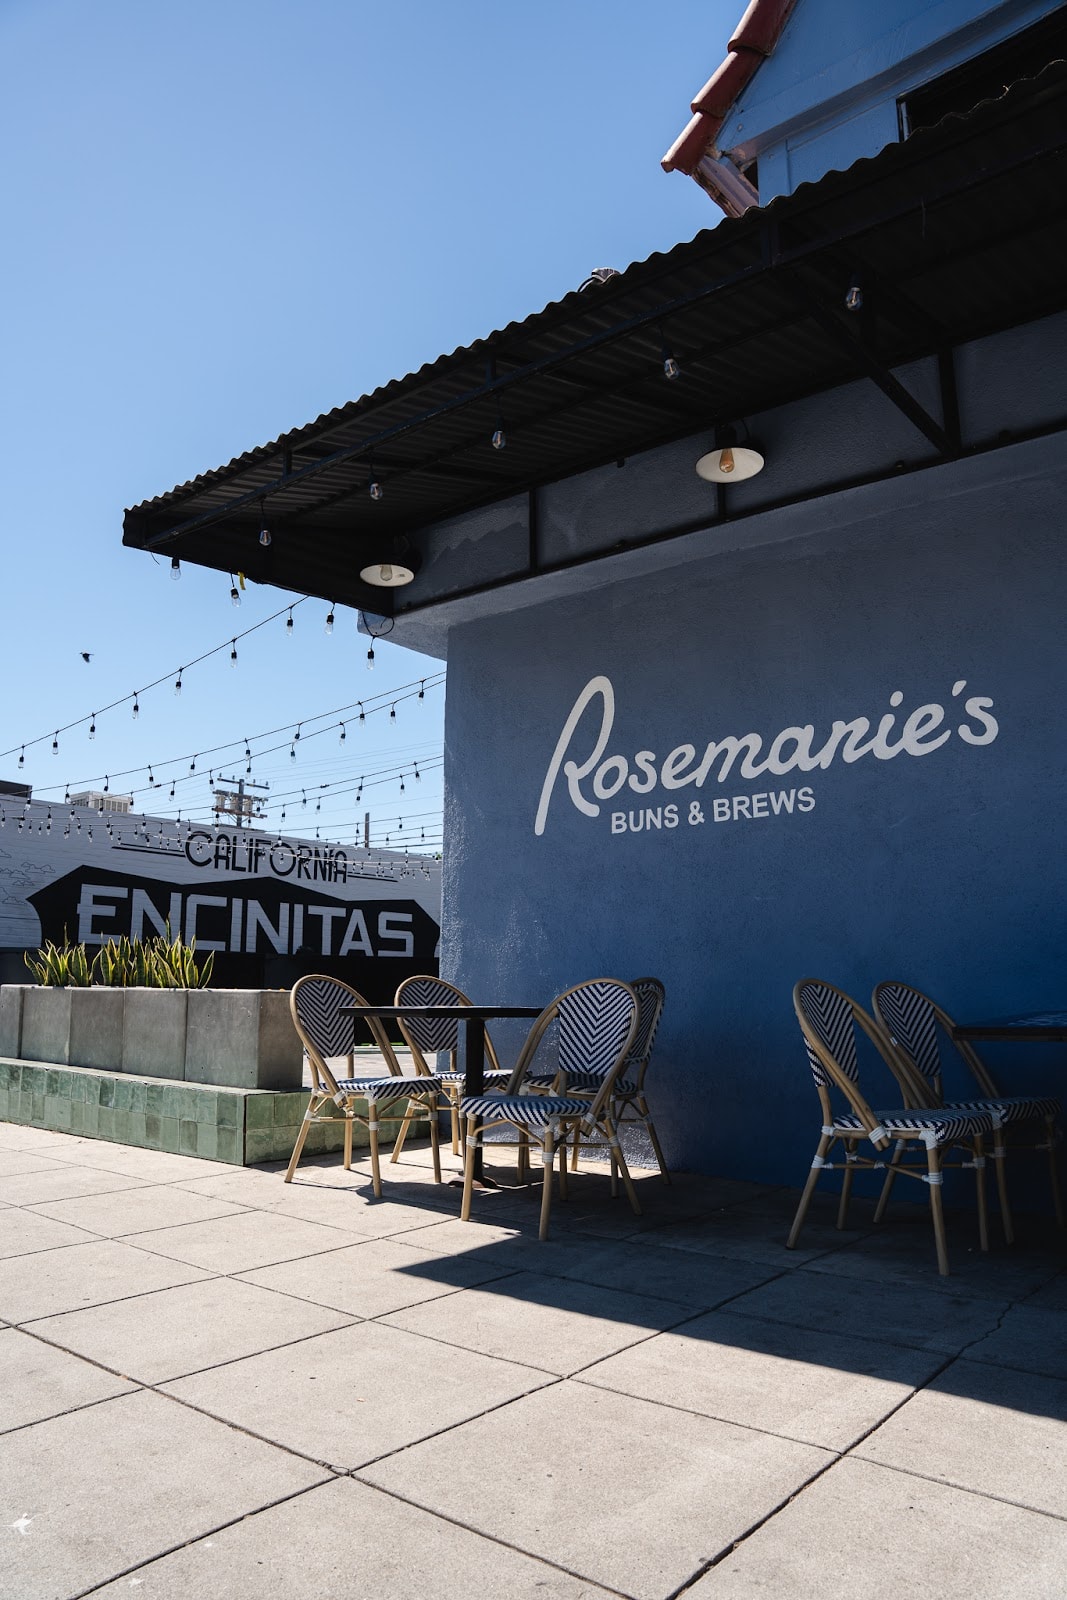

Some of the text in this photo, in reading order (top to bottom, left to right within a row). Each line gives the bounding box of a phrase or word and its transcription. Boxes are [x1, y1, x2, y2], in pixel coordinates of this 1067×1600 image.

[611, 786, 816, 834] BUNS & BREWS
[185, 830, 347, 883] CALIFORNIA
[76, 883, 415, 958] ENCINITAS
